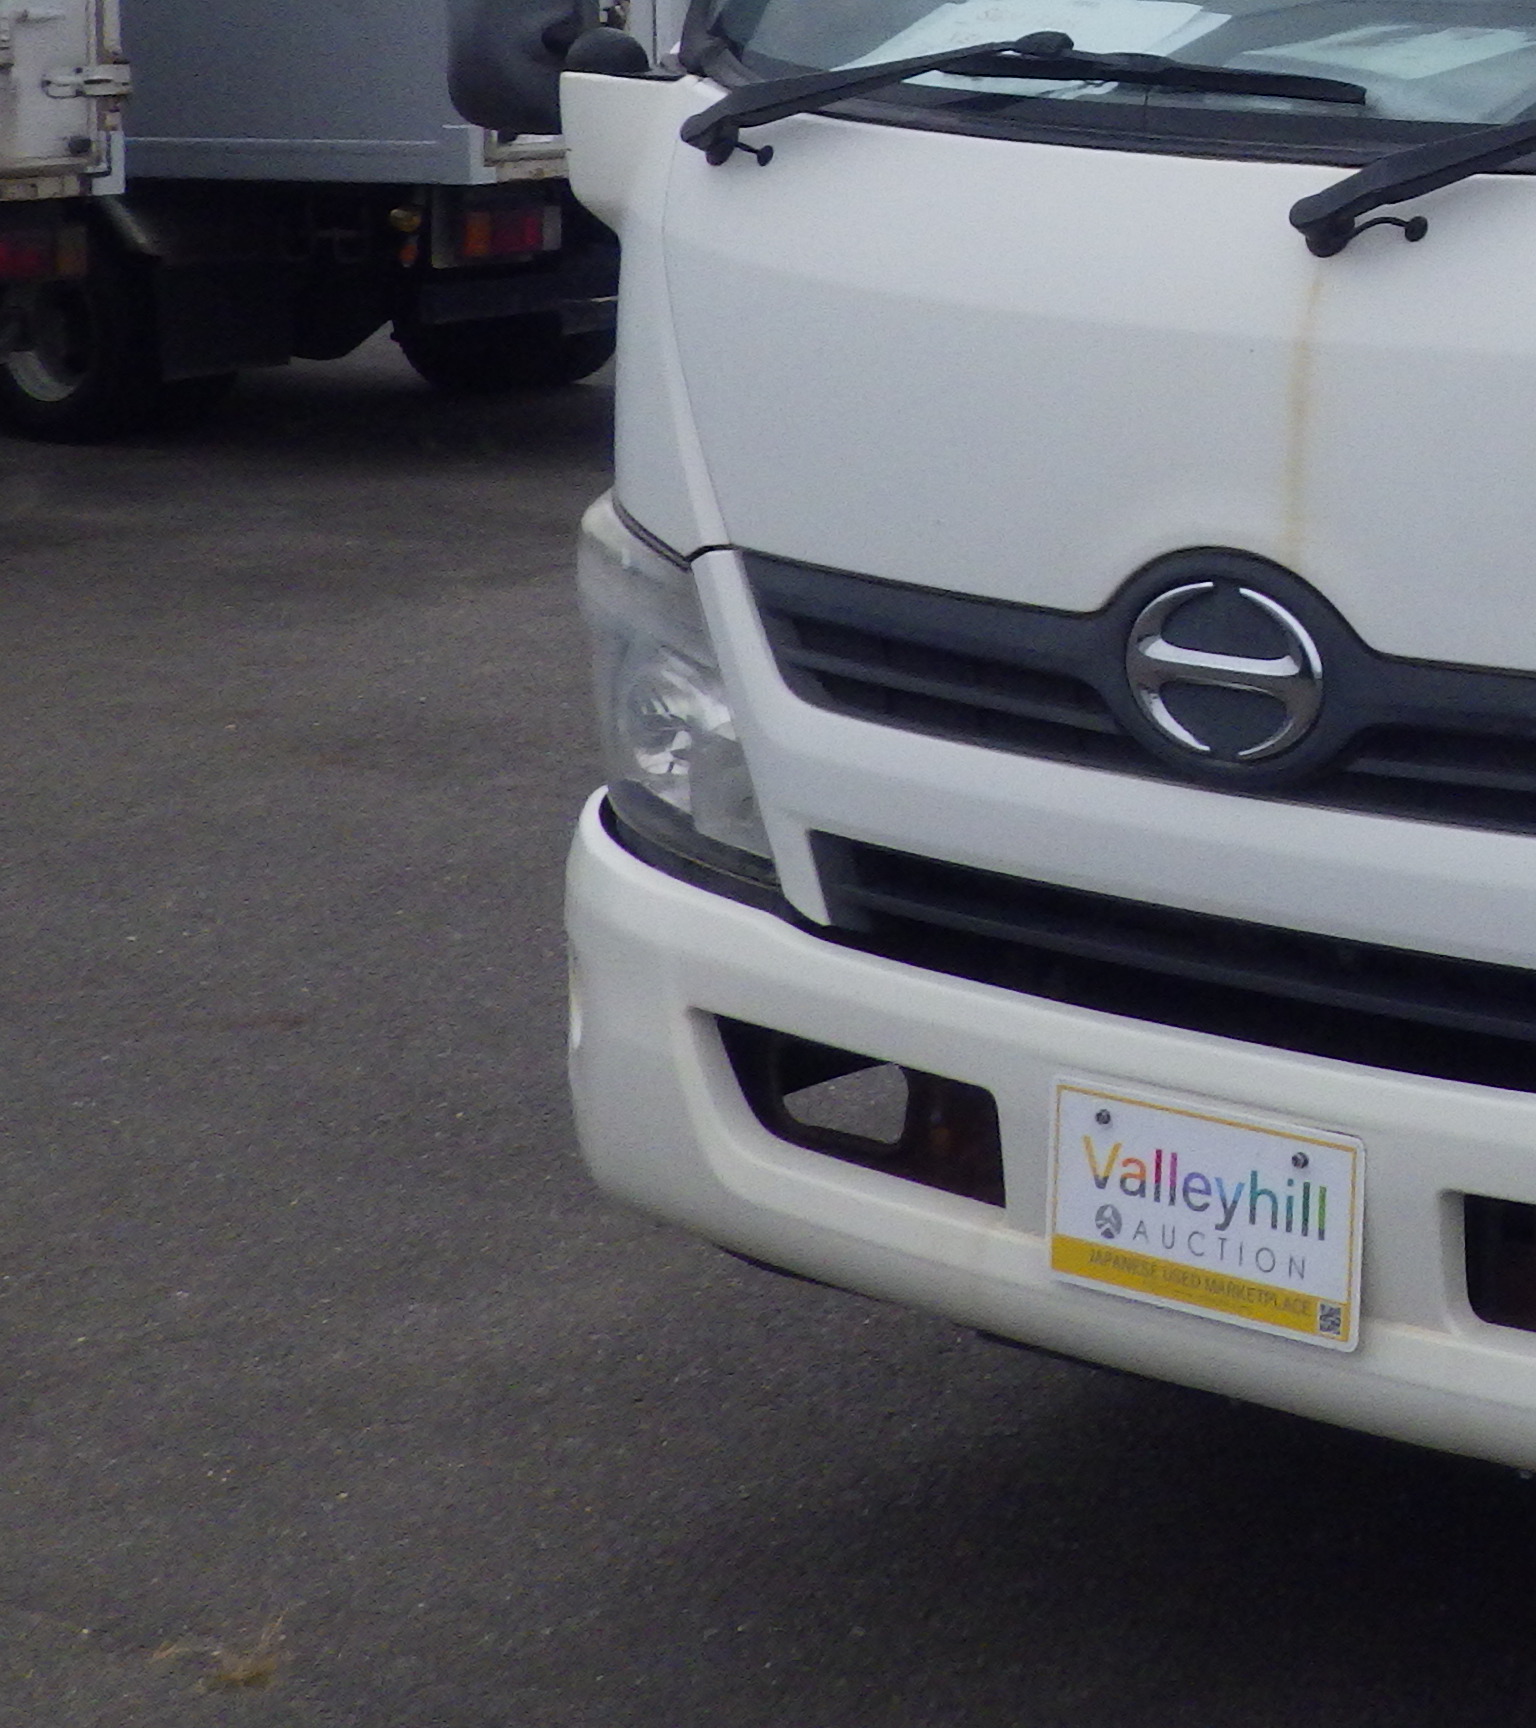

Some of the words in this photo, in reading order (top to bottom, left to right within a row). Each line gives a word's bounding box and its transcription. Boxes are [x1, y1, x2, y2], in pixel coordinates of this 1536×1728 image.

[1081, 1134, 1328, 1241] Valleyhill
[1088, 1247, 1158, 1277] JAPANESE
[1162, 1266, 1202, 1289] USED
[1203, 1275, 1312, 1316] MARKETPLACE
[1132, 1219, 1306, 1281] AUCTION
